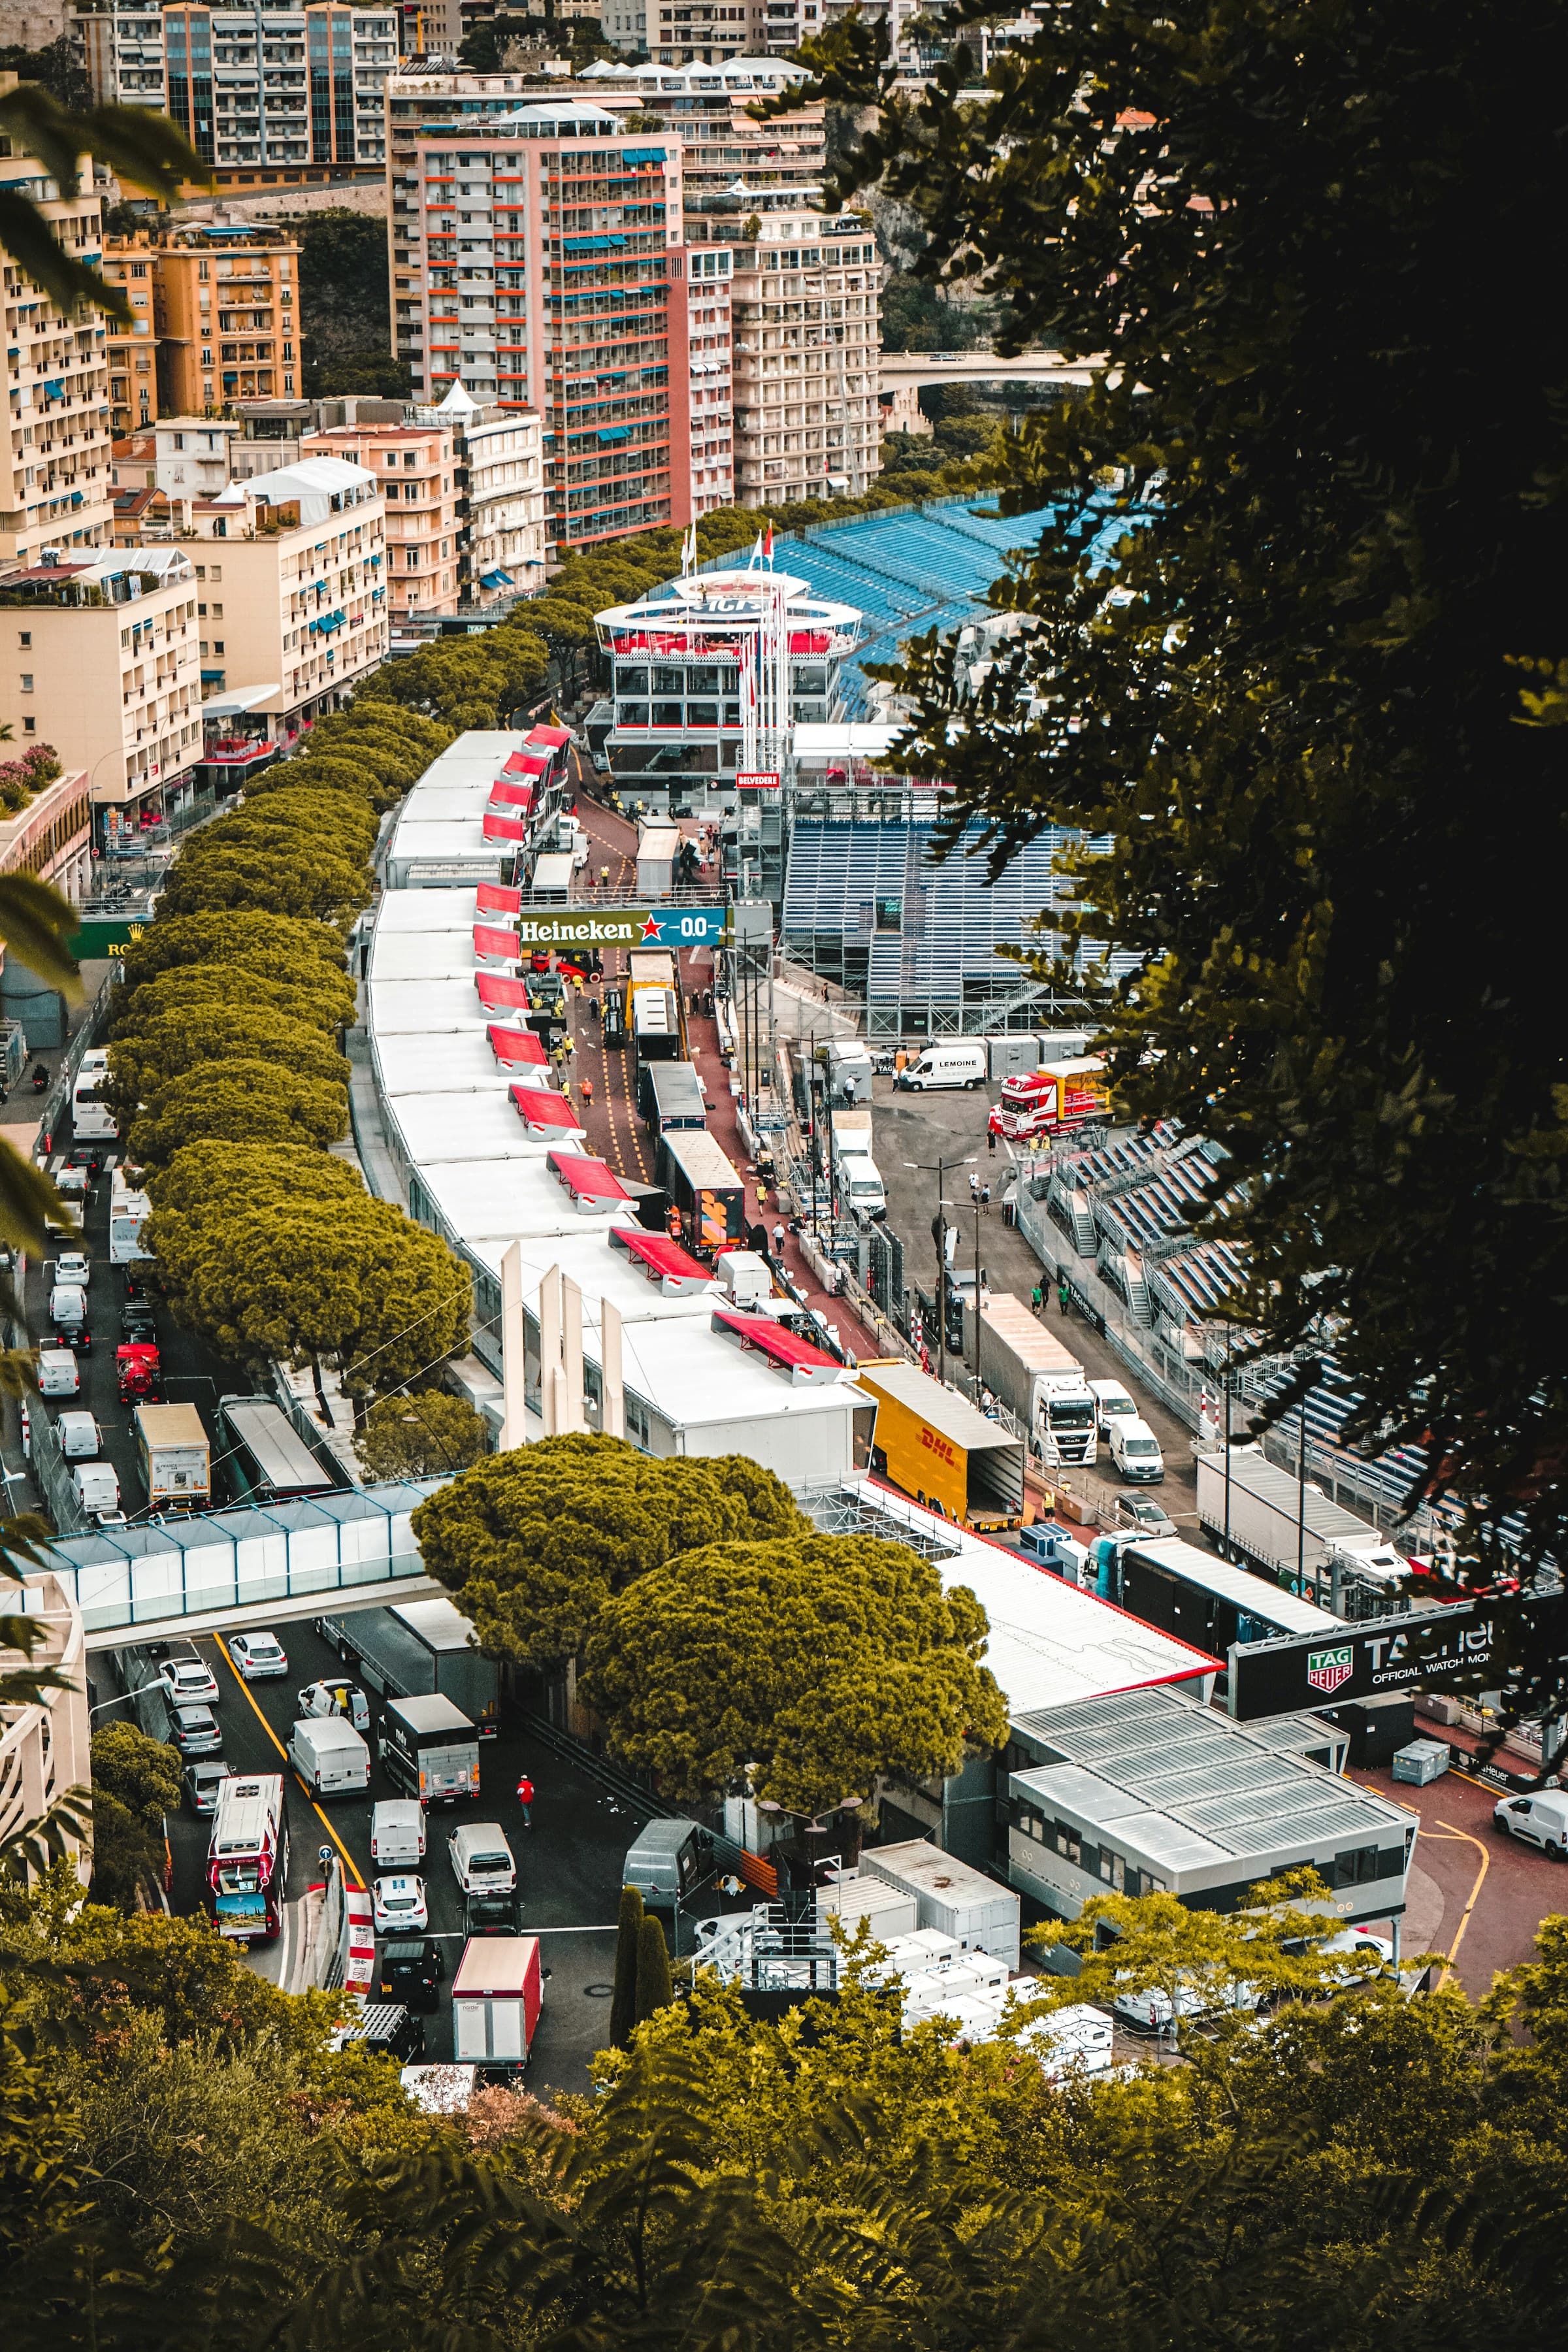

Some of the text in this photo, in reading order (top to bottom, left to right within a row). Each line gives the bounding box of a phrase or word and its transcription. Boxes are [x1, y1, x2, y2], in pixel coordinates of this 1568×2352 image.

[738, 776, 777, 785] BELVEDERE
[521, 920, 633, 941] Heineken
[921, 1427, 955, 1467] DHL
[1312, 1649, 1349, 1669] TAG
[1311, 1665, 1350, 1690] HEUER
[1372, 1667, 1422, 1684] OFFICIAL
[1426, 1657, 1464, 1674] WATCH
[355, 1934, 368, 1946] UBS
[352, 1967, 367, 1980] UBS
